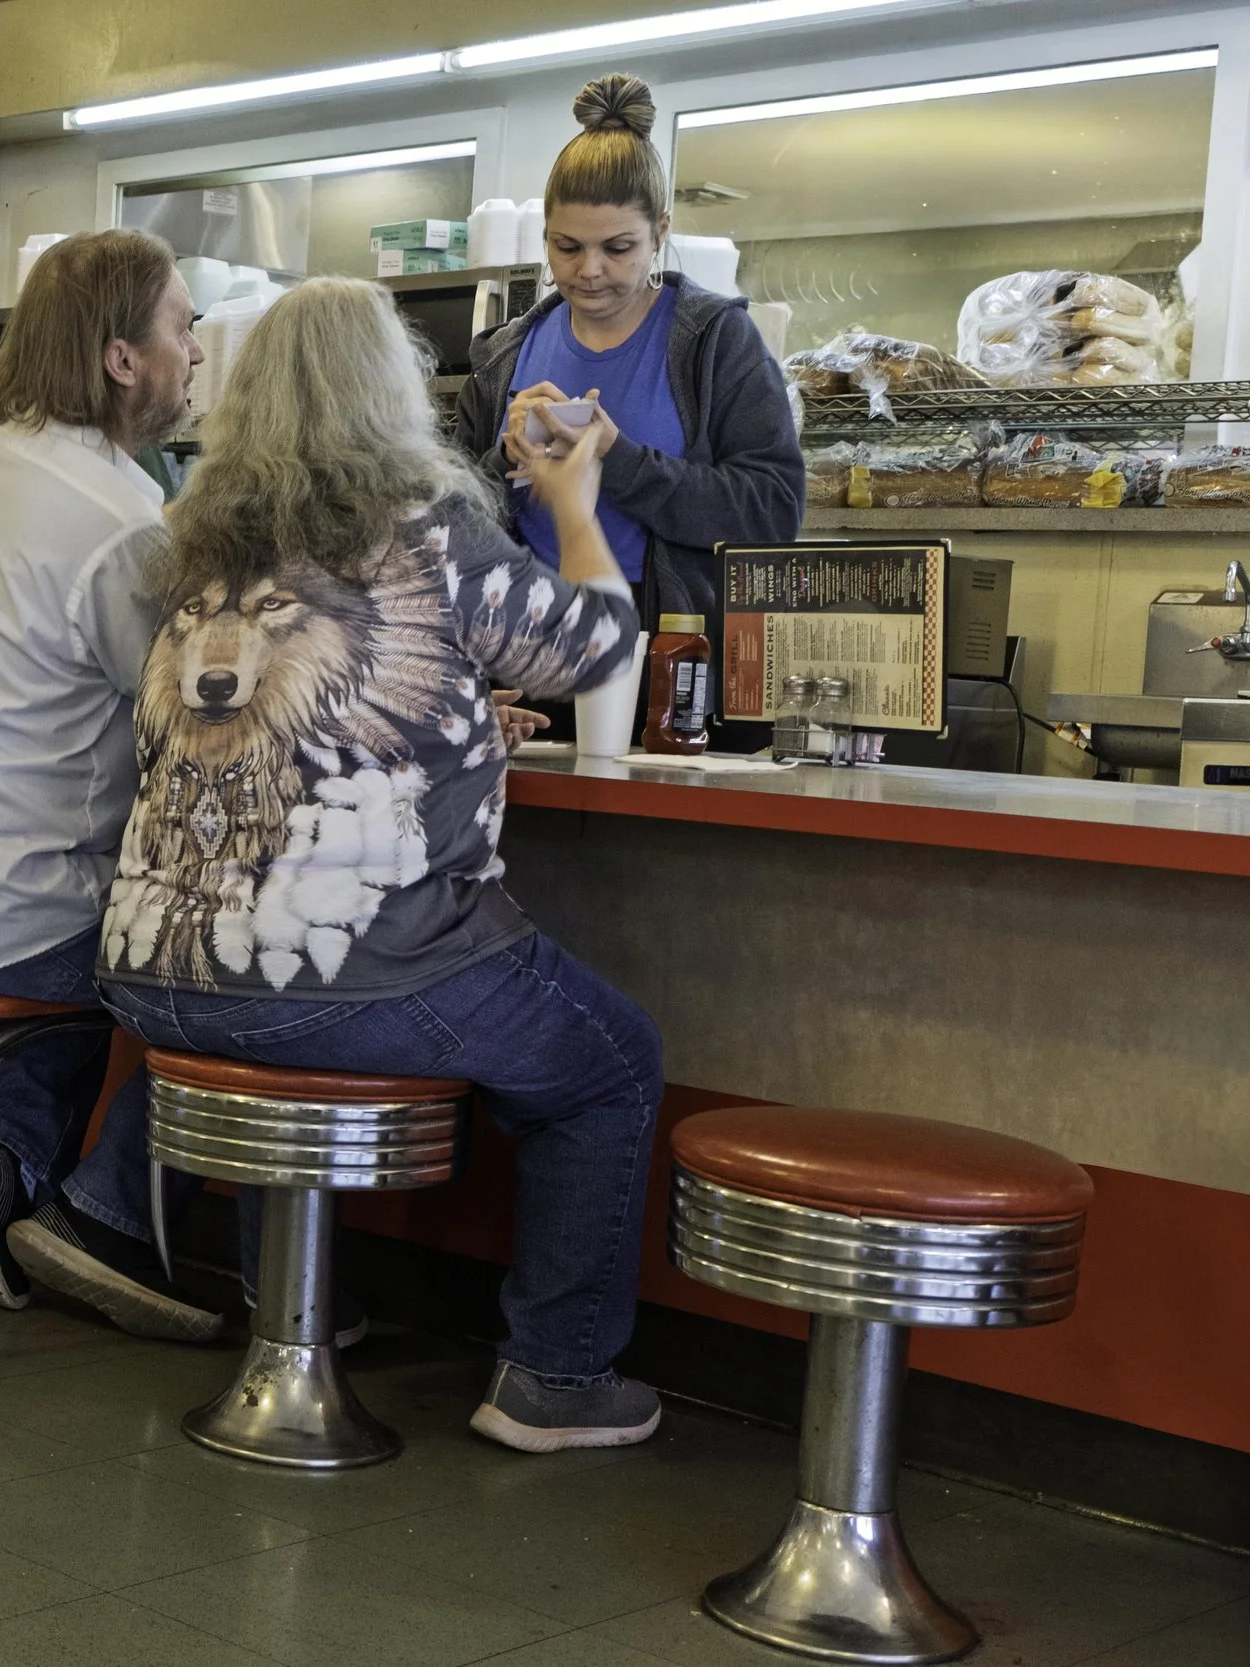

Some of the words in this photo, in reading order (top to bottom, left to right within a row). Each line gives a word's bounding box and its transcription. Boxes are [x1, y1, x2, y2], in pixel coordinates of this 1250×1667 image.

[730, 565, 737, 578] IT
[730, 634, 738, 674] GRILL
[765, 615, 774, 709] SANDWICHES
